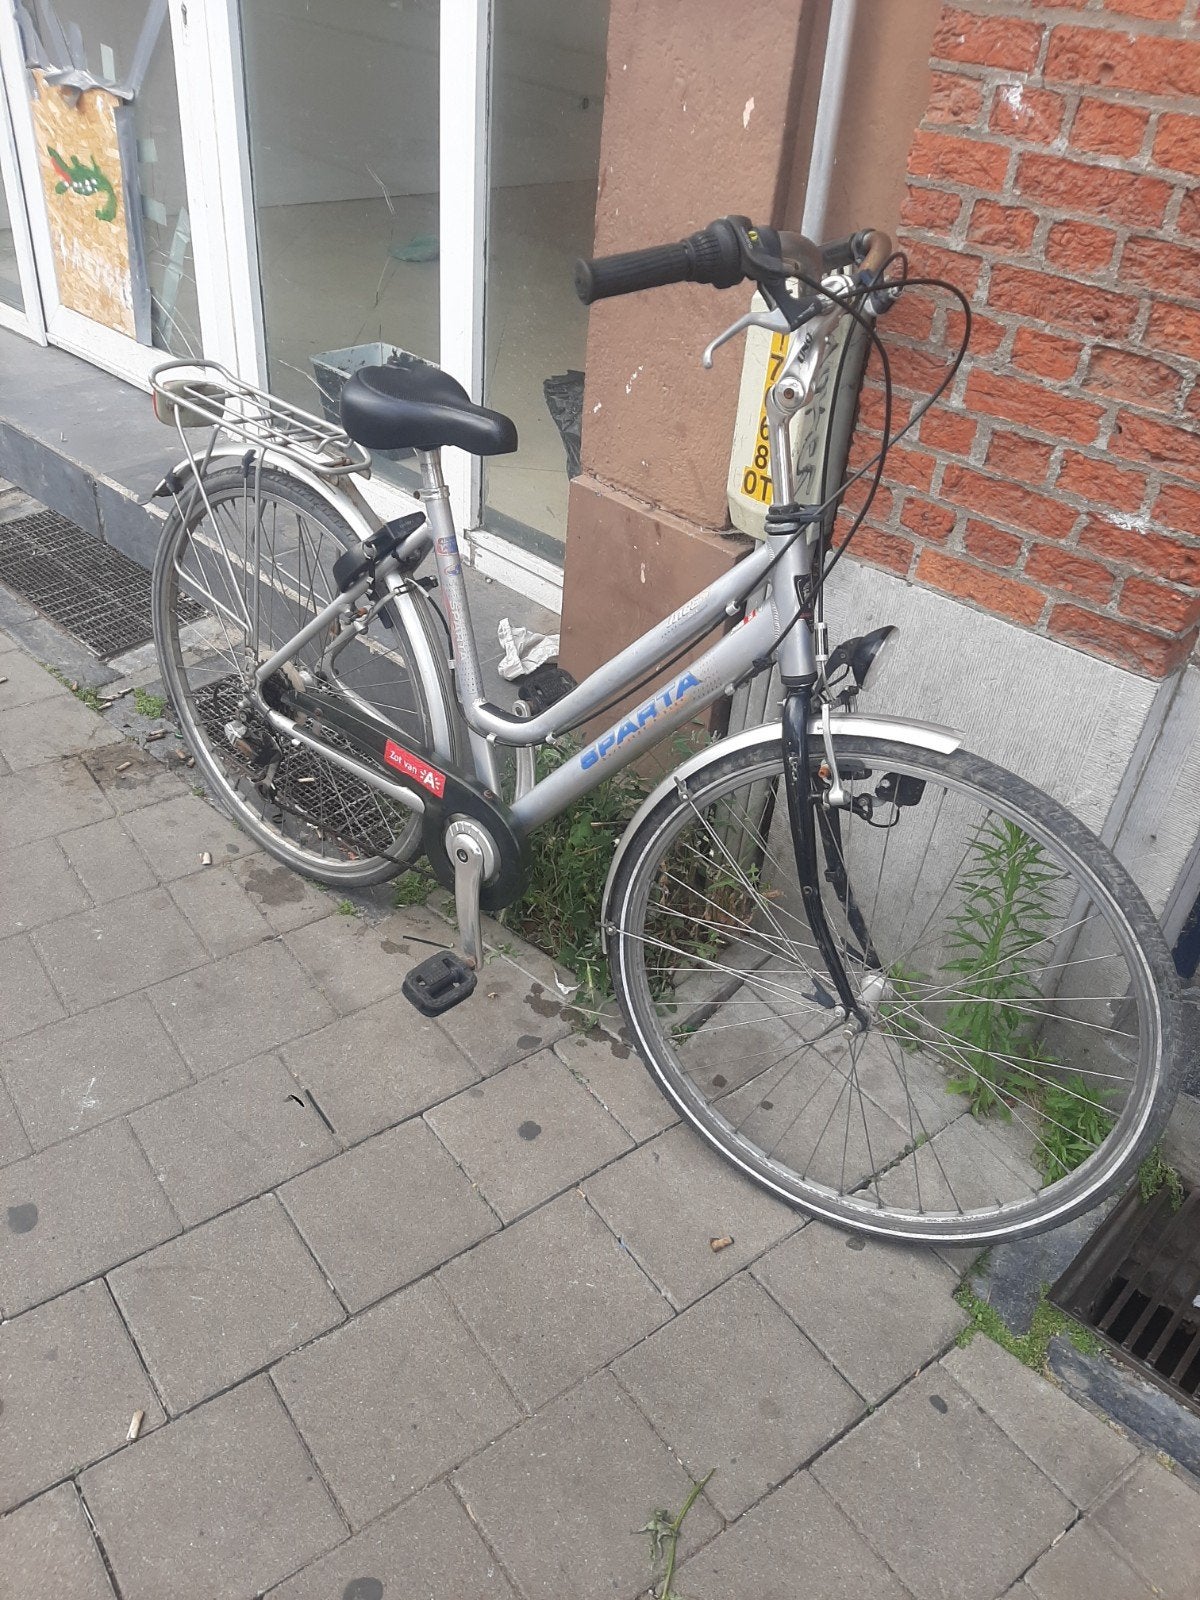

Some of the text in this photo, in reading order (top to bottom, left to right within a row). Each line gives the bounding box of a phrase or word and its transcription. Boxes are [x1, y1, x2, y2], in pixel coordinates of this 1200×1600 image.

[797, 332, 813, 363] UNO
[389, 751, 402, 764] Zot
[404, 760, 417, 775] van
